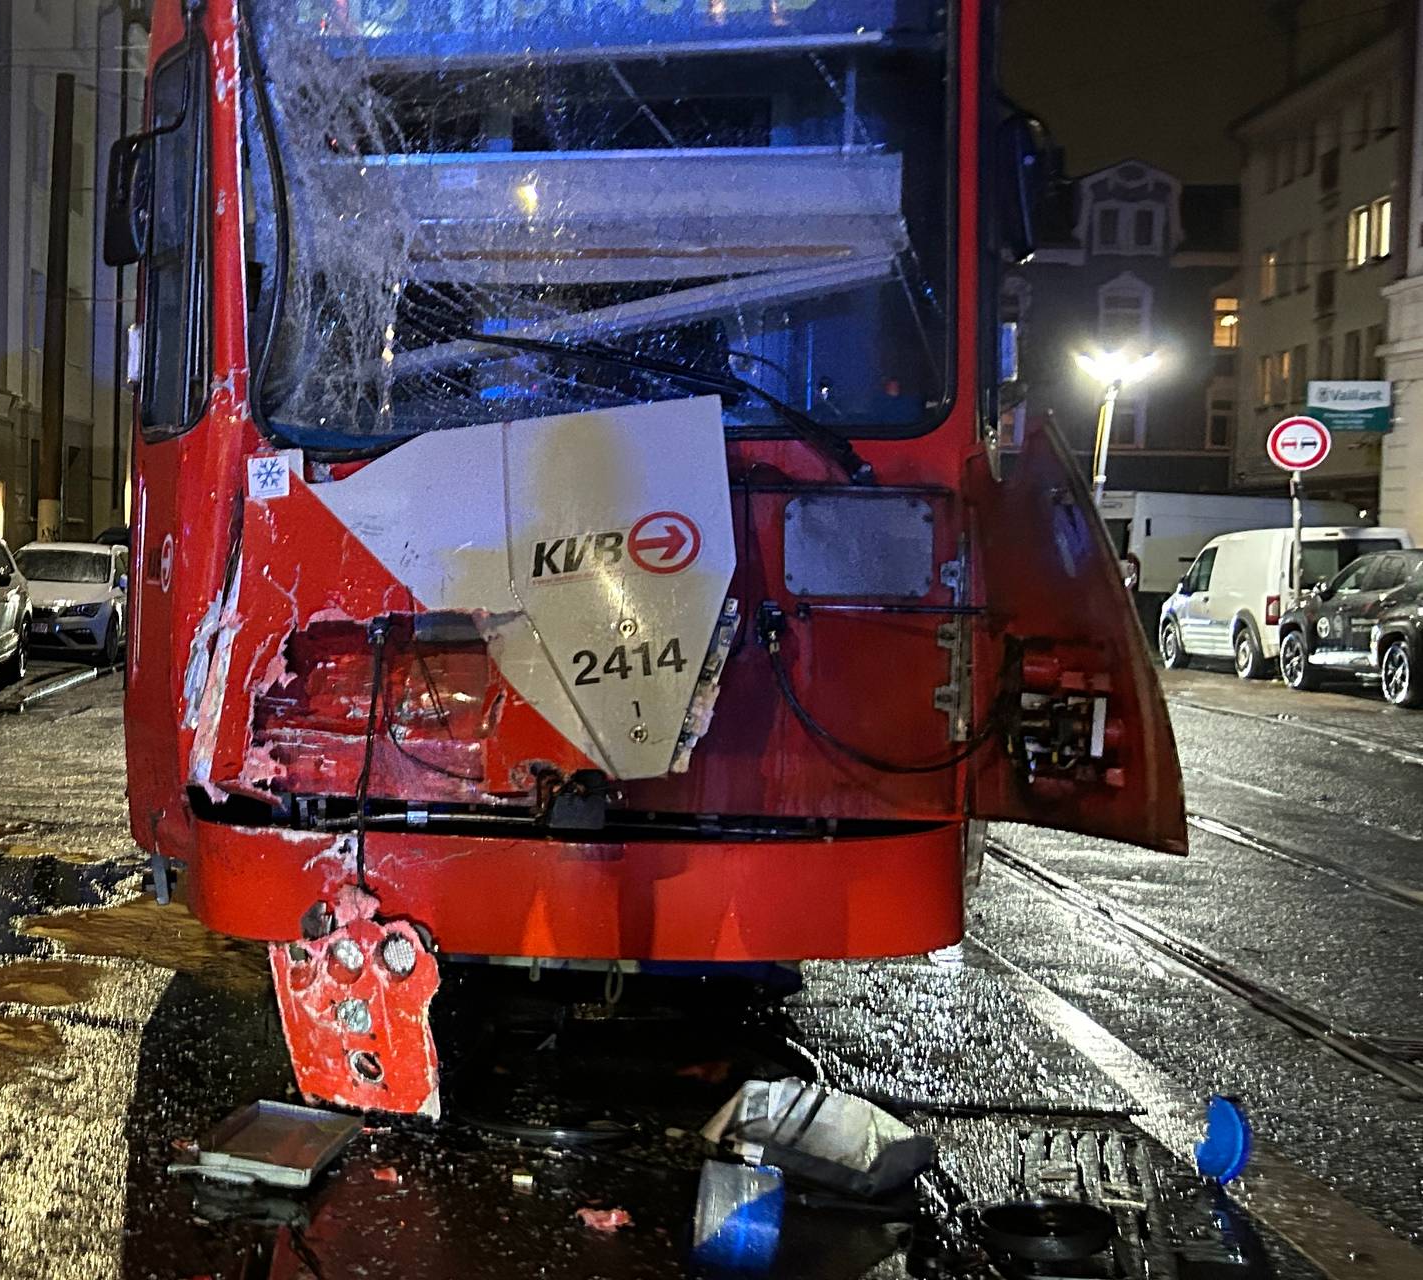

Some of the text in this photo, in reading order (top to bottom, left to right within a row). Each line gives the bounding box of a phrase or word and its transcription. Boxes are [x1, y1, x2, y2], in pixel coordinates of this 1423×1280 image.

[1329, 389, 1382, 402] Vaillant
[532, 531, 624, 577] KVB
[572, 637, 688, 686] 2414
[632, 700, 641, 718] 1
